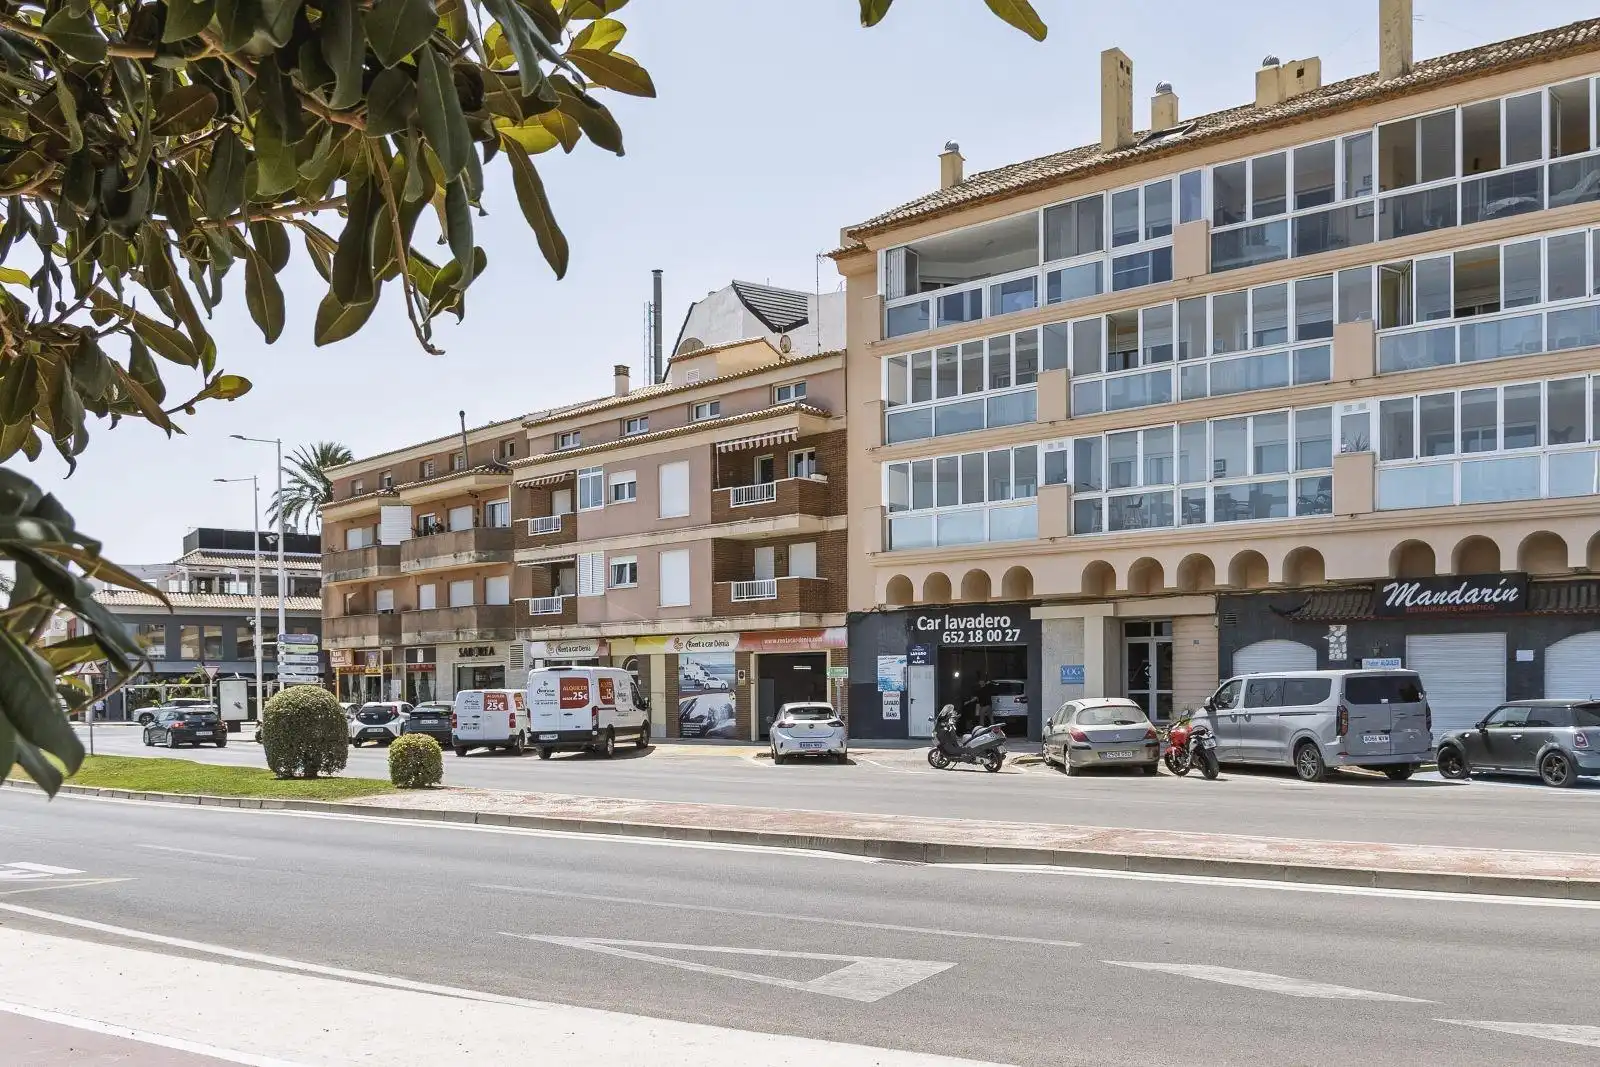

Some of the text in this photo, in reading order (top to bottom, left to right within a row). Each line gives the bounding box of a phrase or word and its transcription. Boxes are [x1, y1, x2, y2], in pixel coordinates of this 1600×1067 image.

[1383, 578, 1519, 607] Mandarín
[1406, 605, 1457, 613] RESTAURANTE
[917, 613, 1011, 630] Car lavadero
[942, 629, 1021, 643] 652 18 00 27
[573, 692, 588, 700] 25€
[487, 702, 505, 711] 25€
